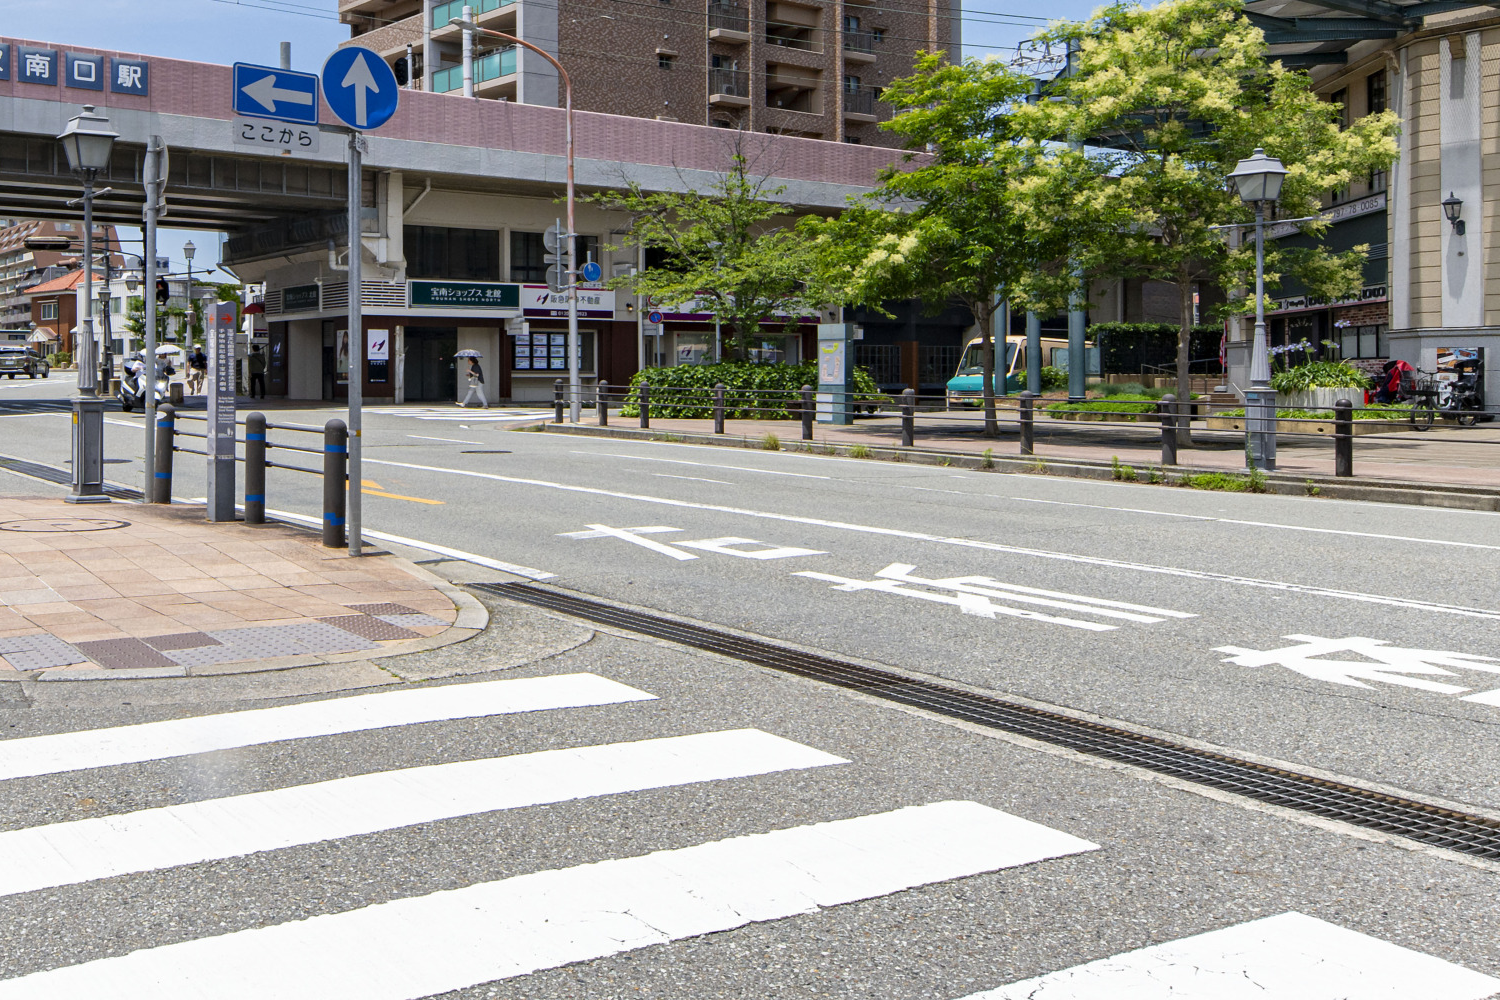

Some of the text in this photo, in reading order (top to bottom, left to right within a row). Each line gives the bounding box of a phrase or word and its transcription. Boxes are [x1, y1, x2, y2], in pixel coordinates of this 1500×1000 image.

[241, 124, 312, 147] ここから
[430, 286, 502, 298] 宝南ショップス 北館
[550, 294, 600, 306] 阪急阪不動産
